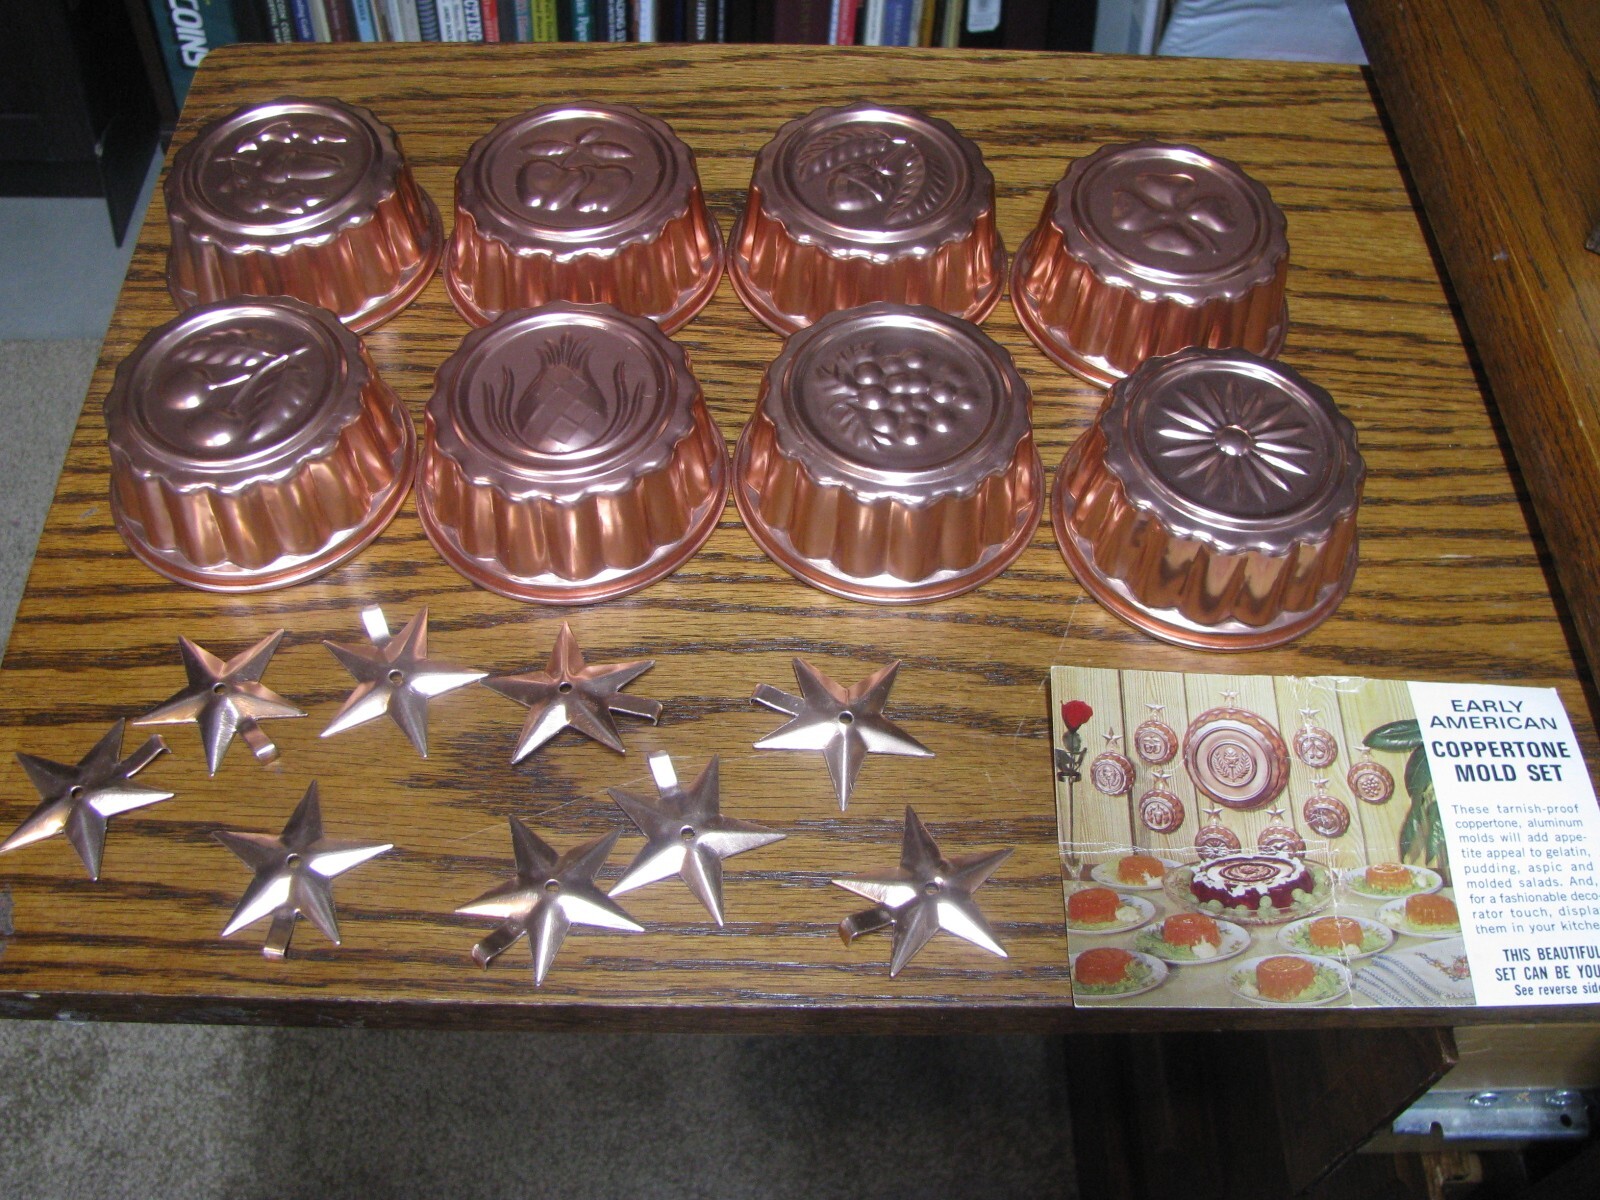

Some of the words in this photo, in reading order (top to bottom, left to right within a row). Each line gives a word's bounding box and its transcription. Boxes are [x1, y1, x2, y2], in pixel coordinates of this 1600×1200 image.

[1451, 699, 1523, 713] EARLY
[1430, 715, 1558, 730] AMERICAN
[1431, 741, 1571, 758] COPPERTONE
[1454, 764, 1517, 782] MOLD
[1526, 764, 1563, 782] SET
[1451, 804, 1490, 815] These
[1497, 803, 1579, 816] tarnish-proof
[1455, 818, 1522, 830] coppertone,
[1527, 817, 1584, 828] aluminum
[1458, 832, 1495, 843] molds
[1500, 832, 1521, 843] will
[1527, 832, 1549, 843] add
[1555, 833, 1588, 845] appe-
[1461, 848, 1482, 859] tite
[1486, 847, 1525, 860] appeal
[1530, 847, 1542, 858] to
[1546, 846, 1591, 859] gelatin,
[1464, 862, 1521, 875] pudding,
[1528, 862, 1563, 874] aspic
[1571, 861, 1594, 872] and
[1467, 878, 1512, 889] molded
[1519, 877, 1563, 888] salads.
[1569, 875, 1598, 888] And,
[1469, 893, 1485, 904] for
[1489, 895, 1497, 904] a
[1499, 891, 1568, 904] fashionable
[1472, 909, 1504, 920] rator
[1510, 907, 1552, 919] touch,
[1475, 924, 1507, 935] them
[1512, 922, 1525, 933] in
[1529, 923, 1556, 935] your
[1560, 920, 1600, 931] kitche
[1502, 948, 1531, 962] THIS
[1537, 945, 1600, 961] BEAUTIFUL
[1495, 967, 1517, 982] SET
[1524, 966, 1549, 981] CAN
[1555, 965, 1571, 979] BE
[1577, 964, 1600, 979] YOU
[1514, 984, 1534, 996] See
[1539, 985, 1578, 996] reverse
[1582, 981, 1600, 994] sid
